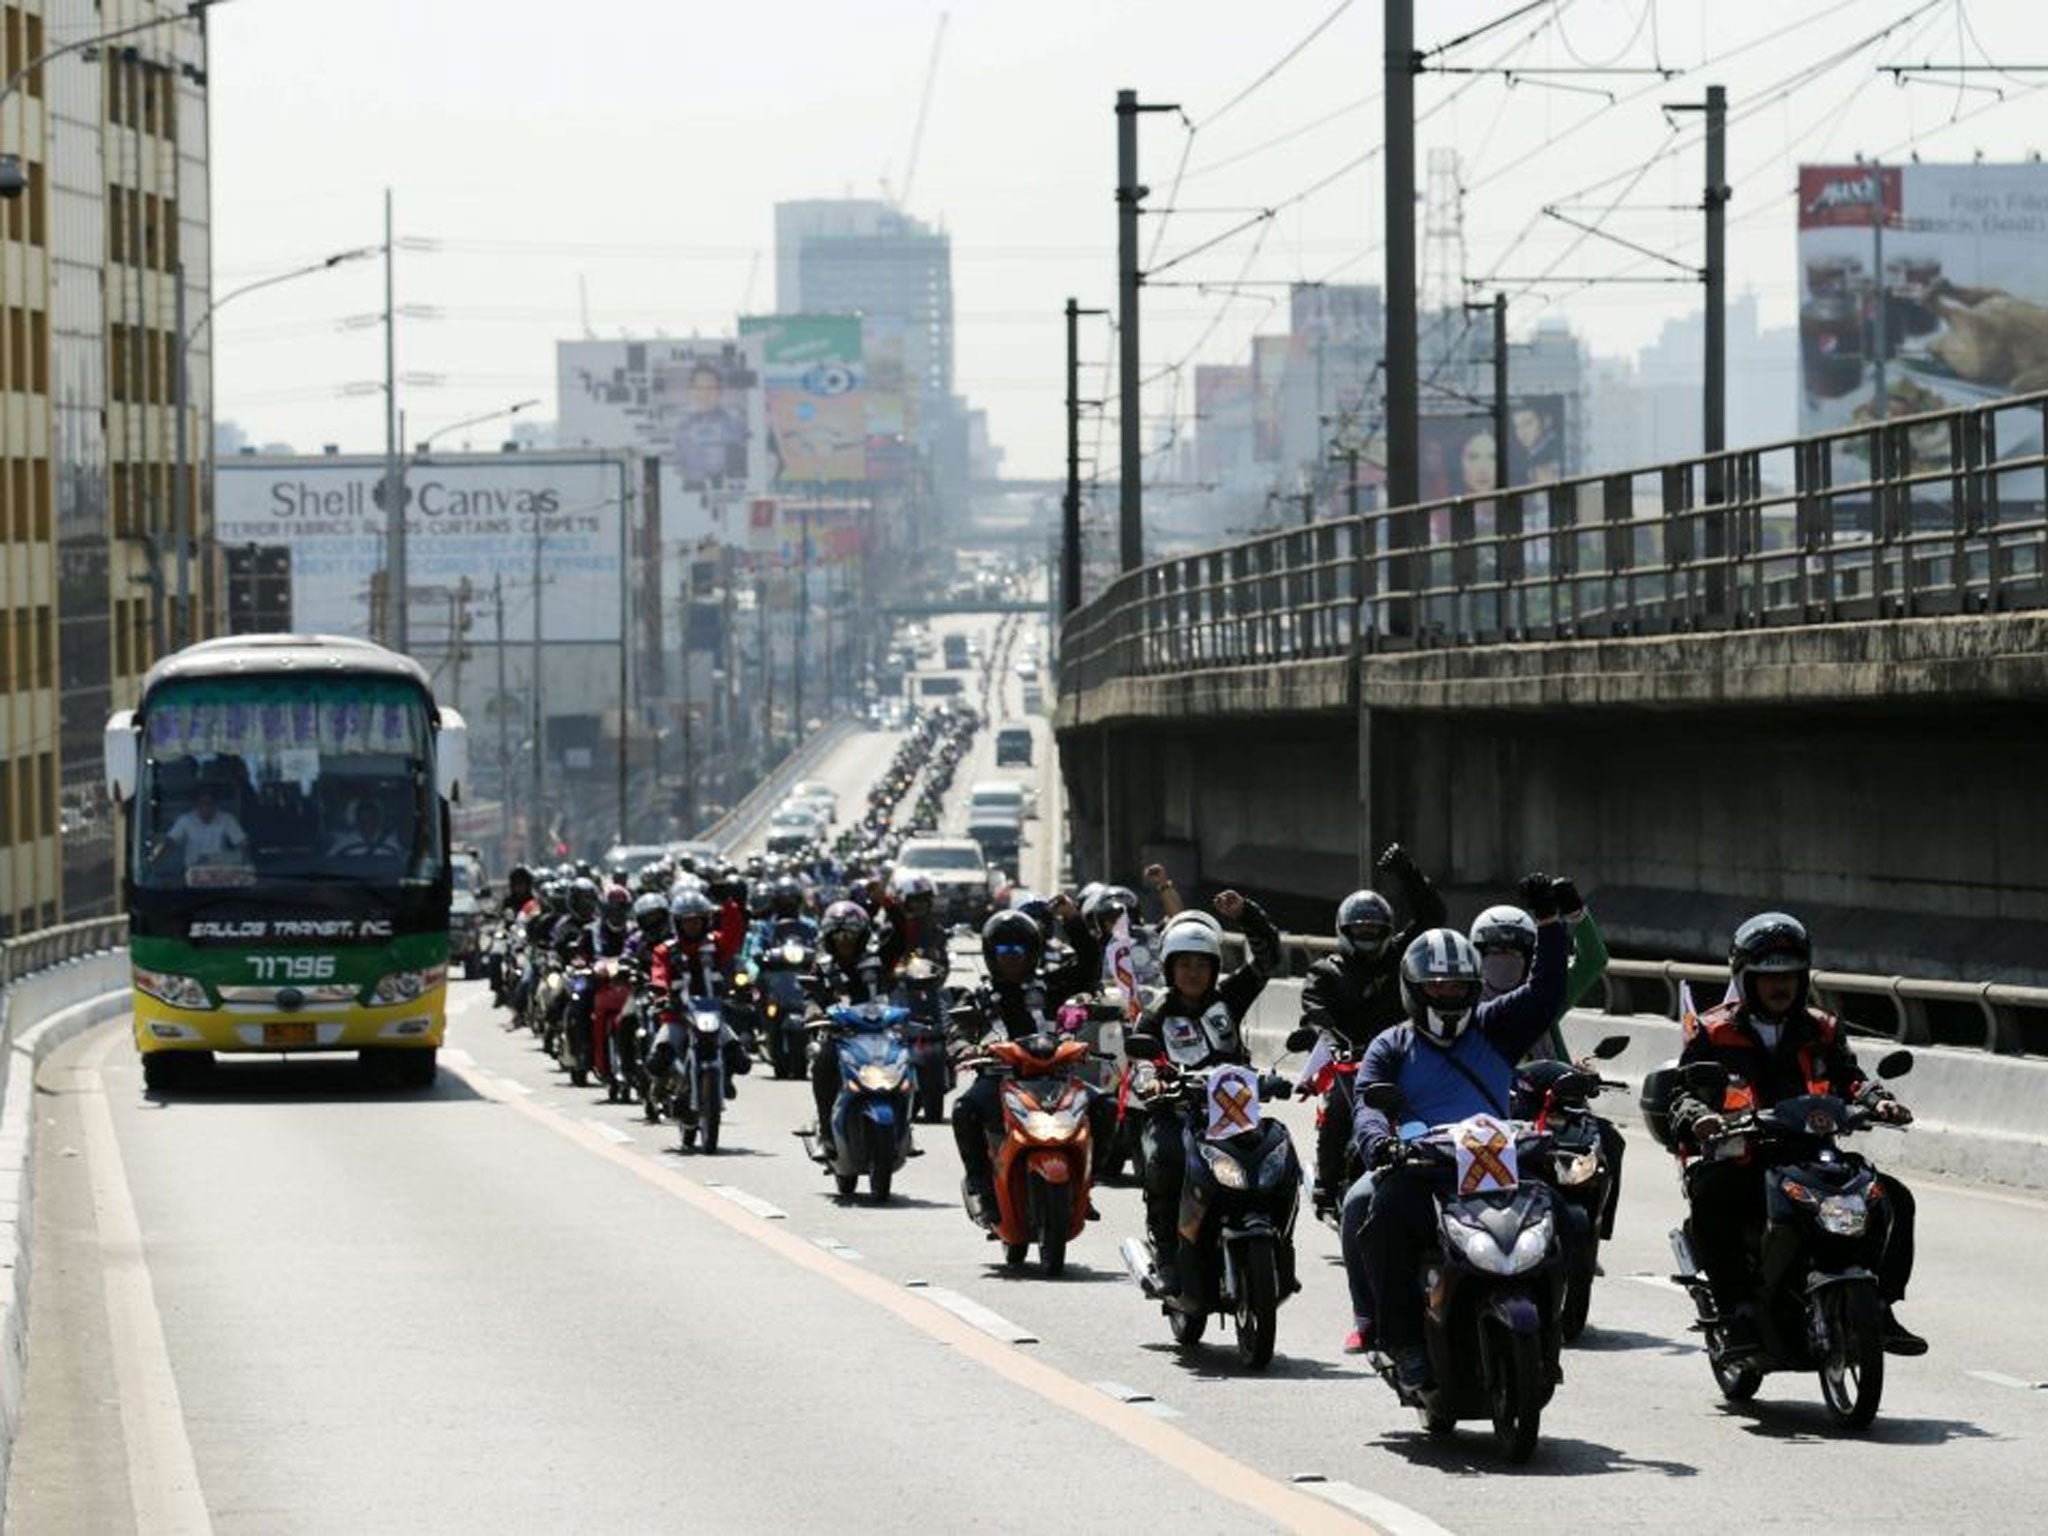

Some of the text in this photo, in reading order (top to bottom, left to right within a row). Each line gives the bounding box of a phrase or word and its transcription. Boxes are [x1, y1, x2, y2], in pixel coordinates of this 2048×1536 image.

[271, 481, 560, 519] Shell Canvas
[221, 520, 282, 536] TERIOR
[284, 520, 354, 536] FABRICS
[429, 518, 511, 535] CURTAINS
[246, 956, 336, 979] 71796
